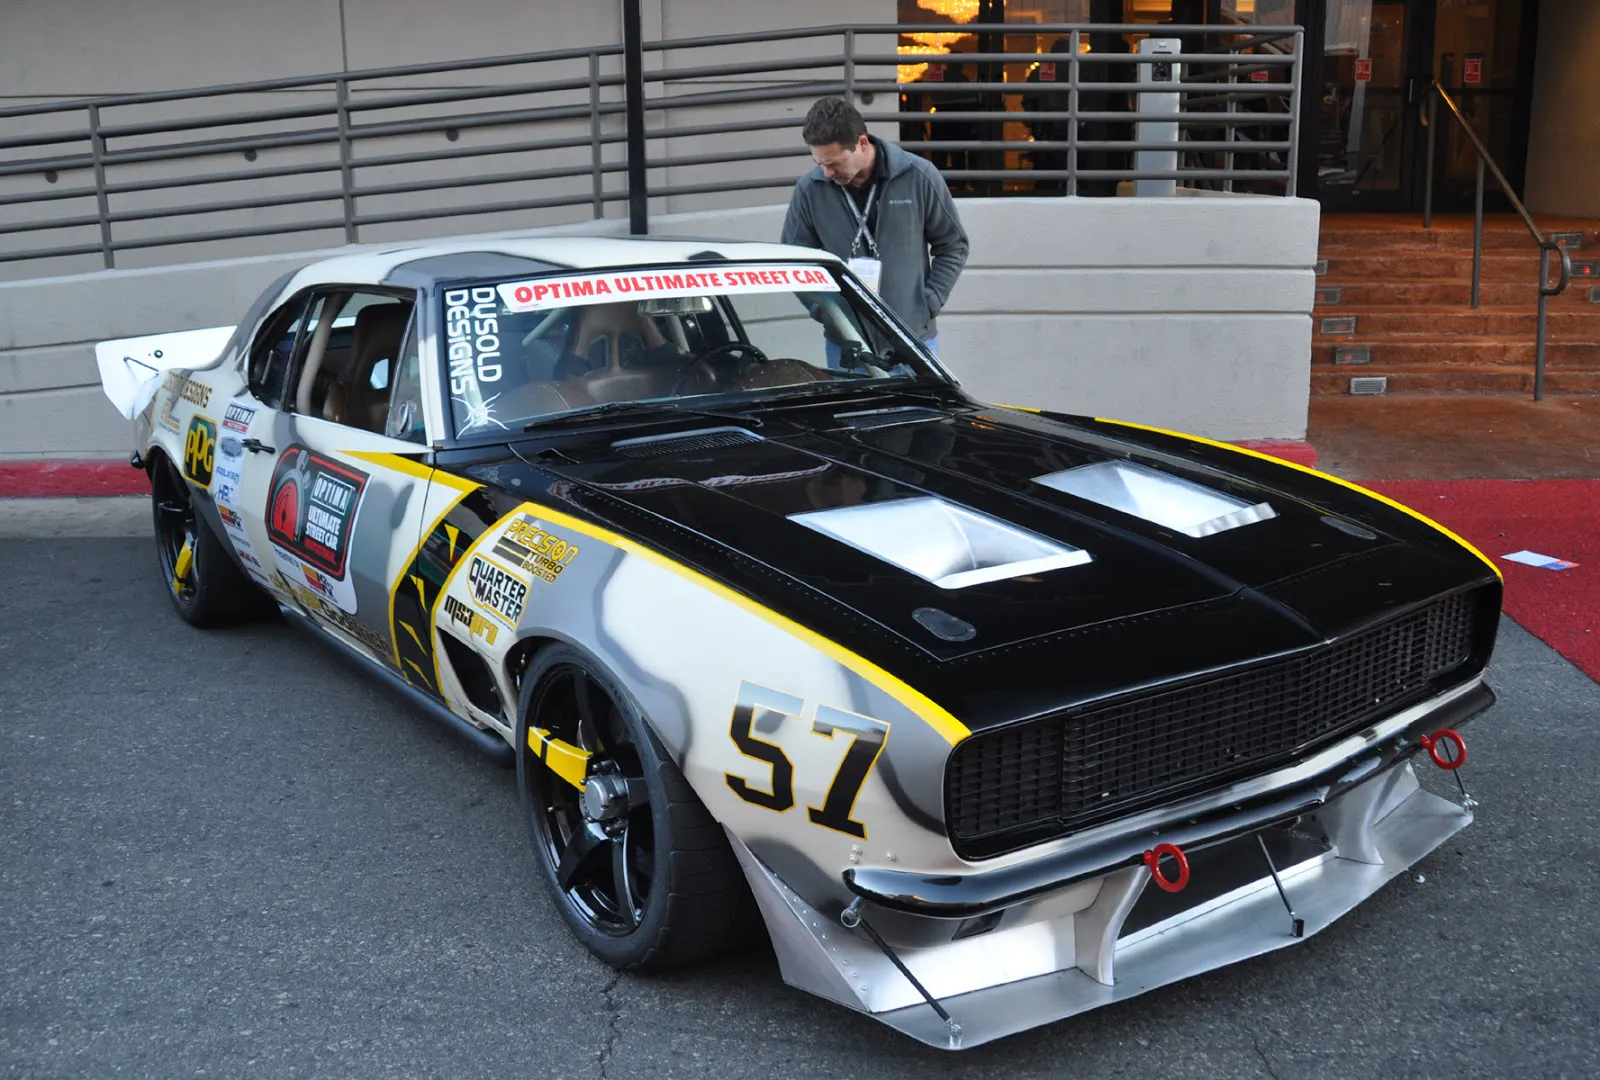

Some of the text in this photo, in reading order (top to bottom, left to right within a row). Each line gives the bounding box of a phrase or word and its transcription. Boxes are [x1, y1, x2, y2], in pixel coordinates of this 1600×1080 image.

[514, 269, 829, 304] OPTIMA ULTIMATE STREET CAR
[471, 287, 502, 382] DUSOLD
[313, 477, 348, 510] OPTIMA
[305, 521, 326, 545] STREET
[324, 531, 339, 551] CAR
[308, 505, 341, 535] ULTIMATE
[504, 518, 579, 566] PRECISION
[469, 556, 527, 603] QUARTER
[521, 561, 557, 584] BOOSTED
[529, 550, 563, 574] TURBO
[475, 580, 523, 625] MASTER
[724, 680, 892, 841] 57
